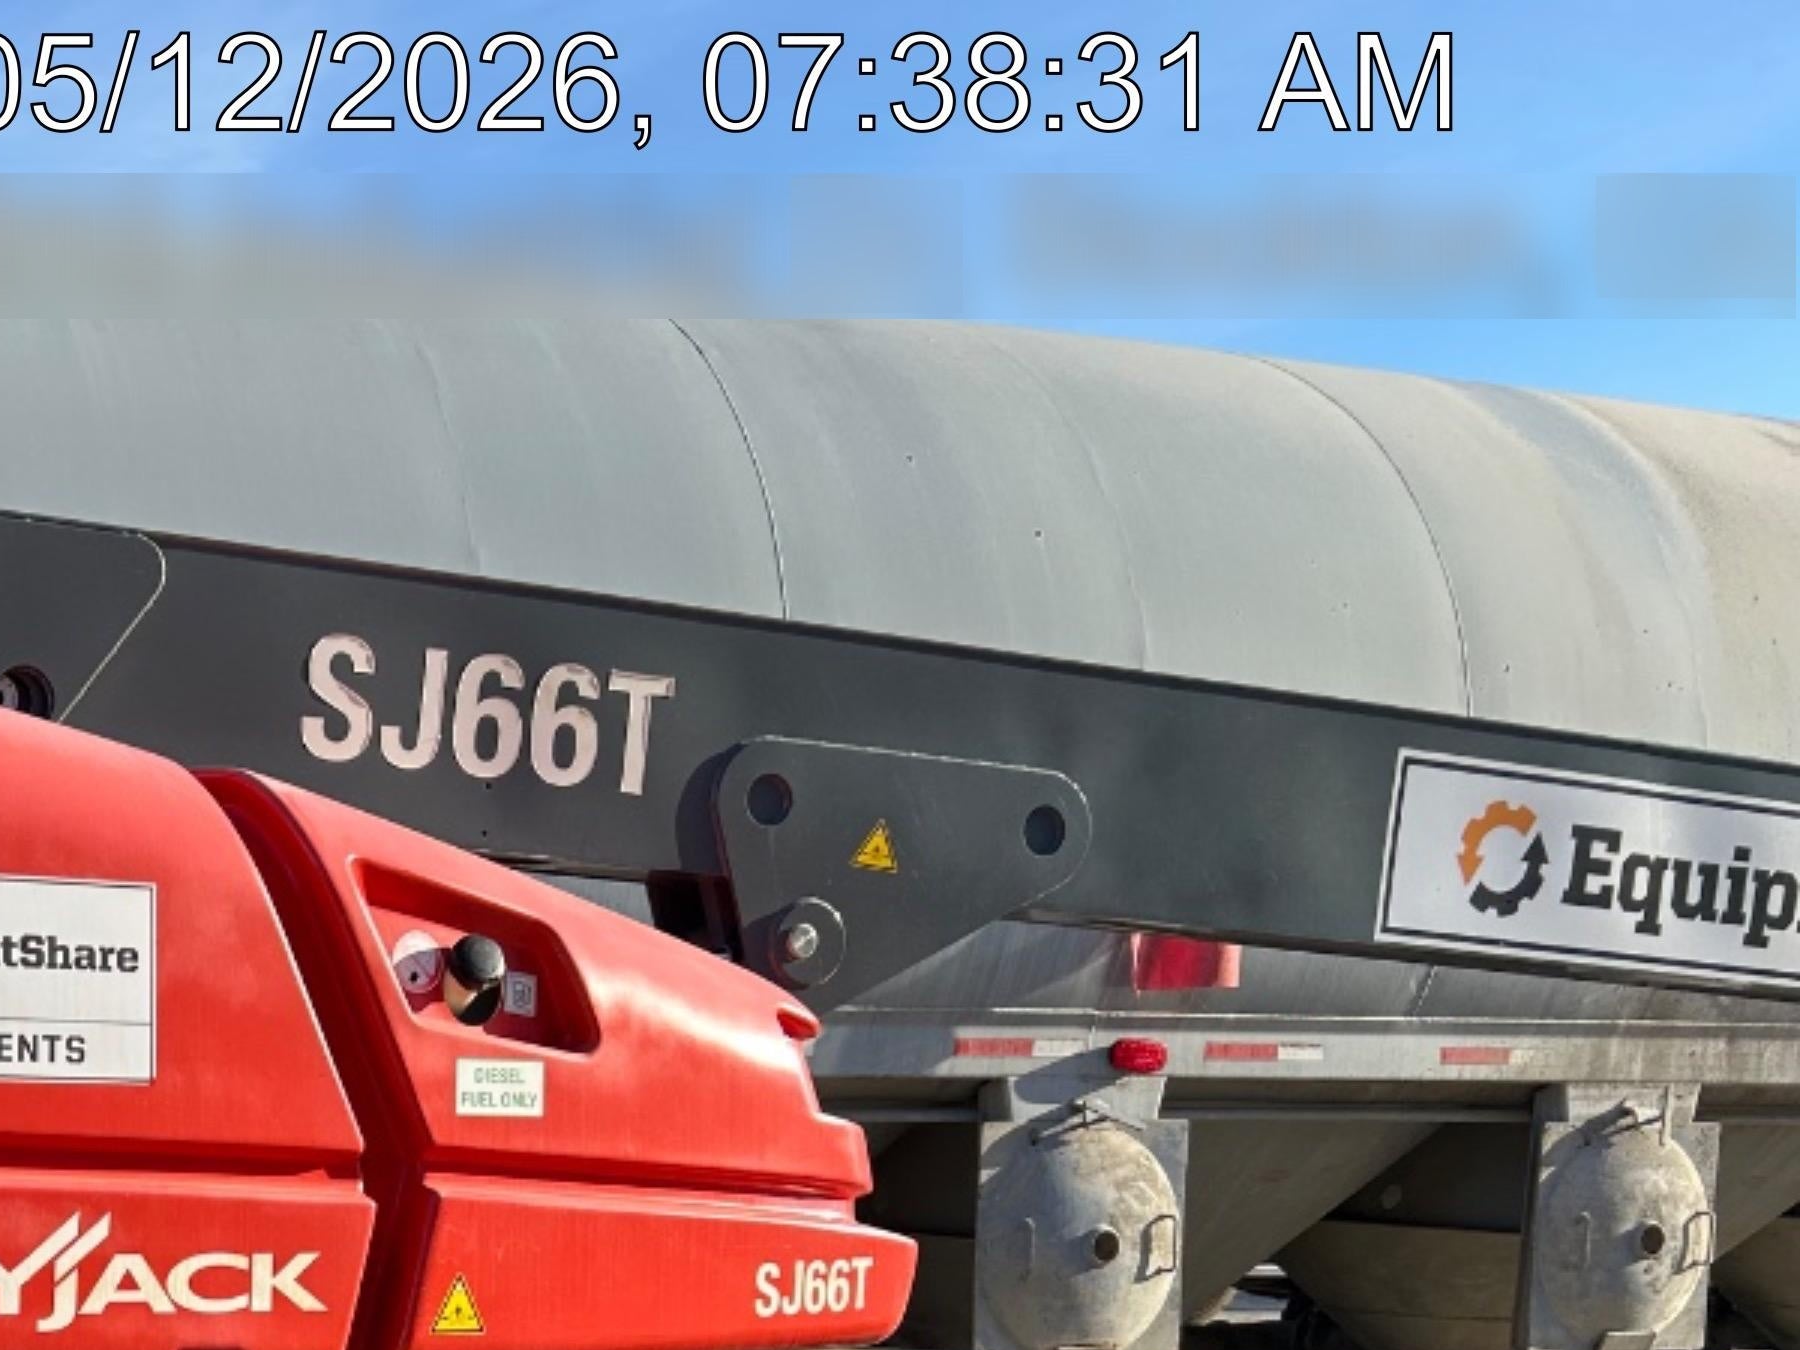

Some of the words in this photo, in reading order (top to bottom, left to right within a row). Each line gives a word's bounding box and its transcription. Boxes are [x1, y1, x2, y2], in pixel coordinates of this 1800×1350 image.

[301, 632, 676, 796] SJ66T
[1560, 823, 1800, 949] Equip
[460, 1090, 497, 1109] FUEL
[500, 1090, 538, 1109] ONLY
[473, 1066, 527, 1085] DIESEL
[754, 1256, 874, 1318] SJ66T
